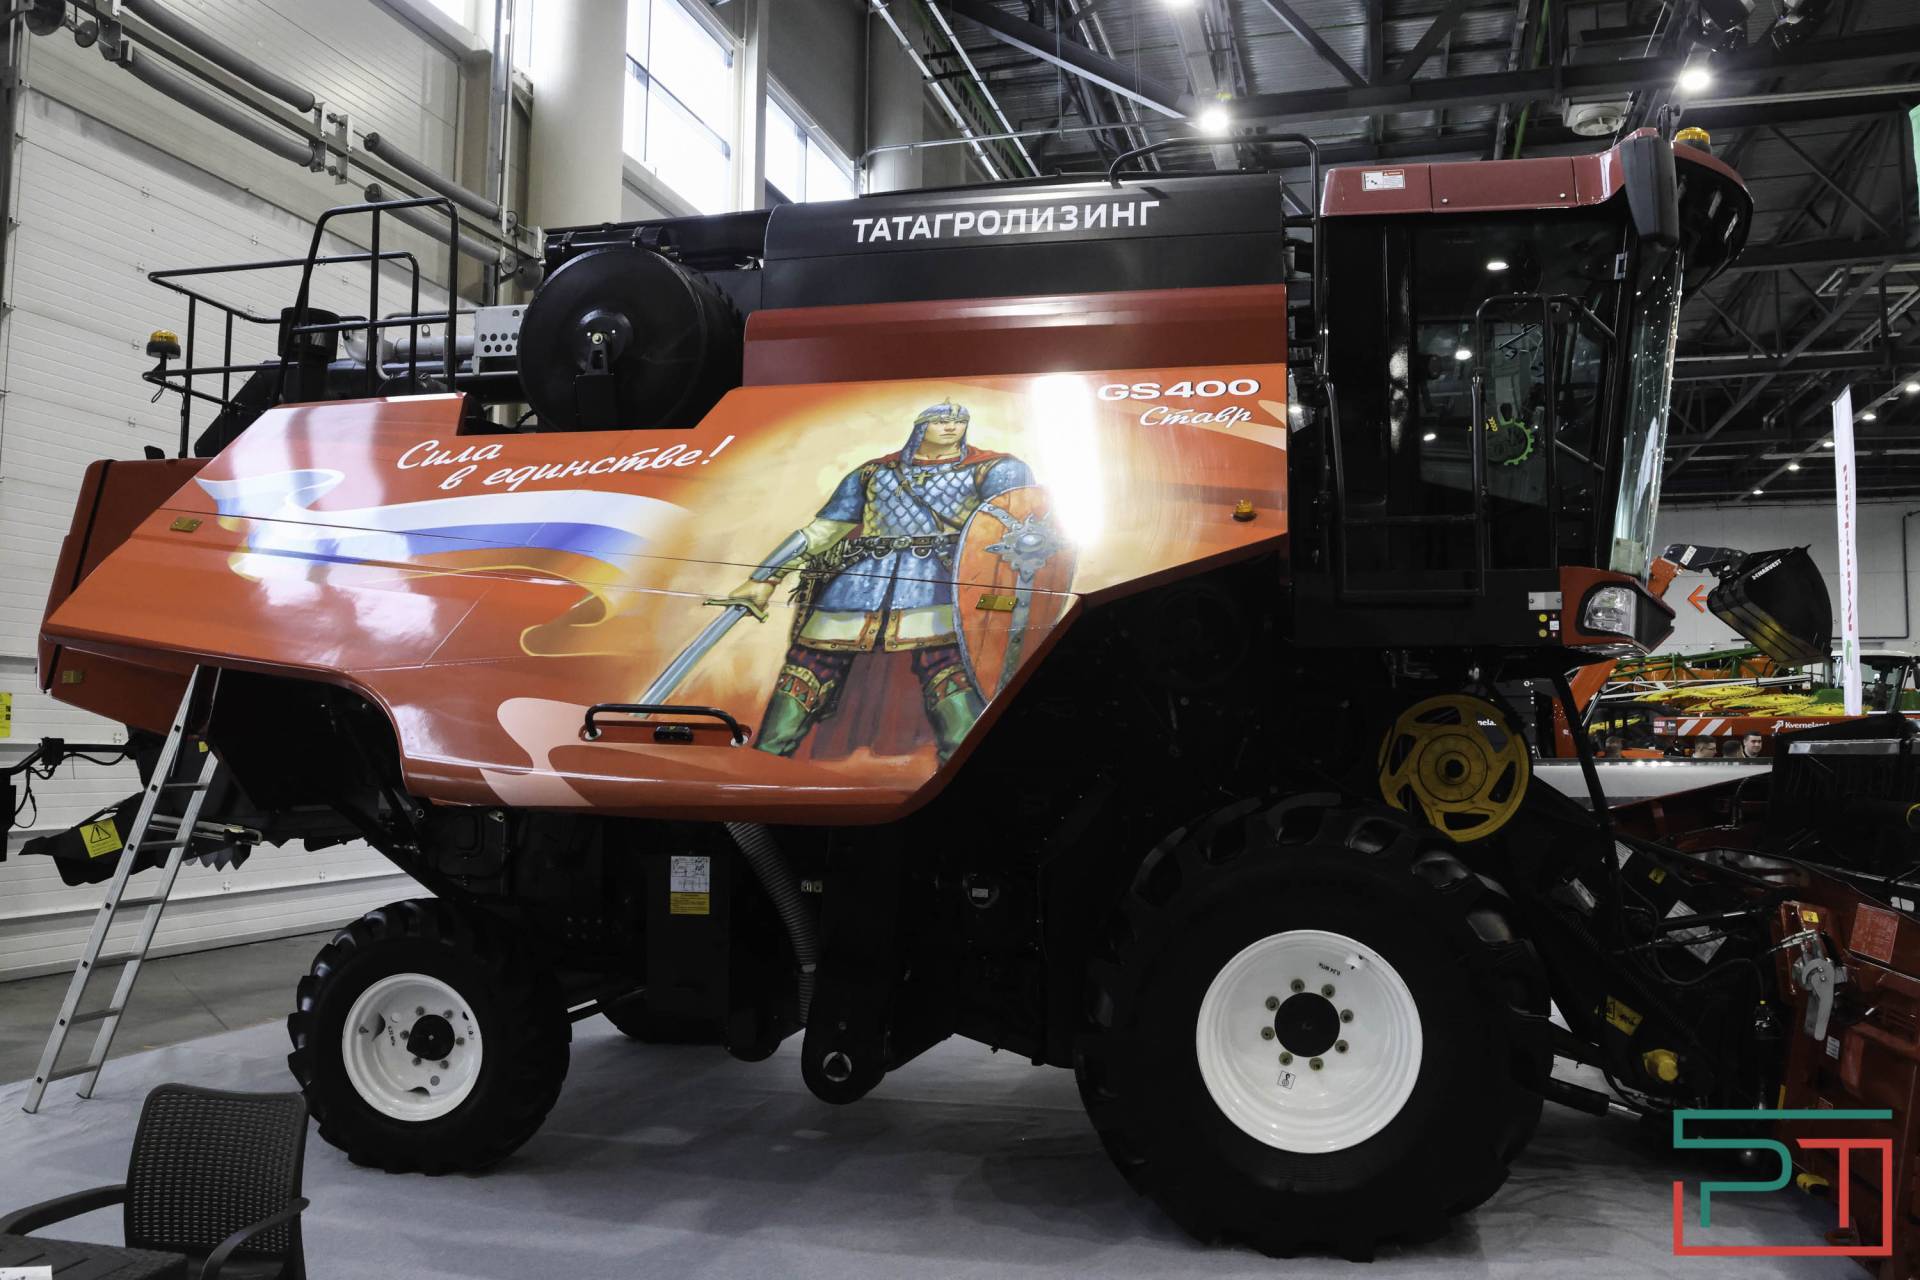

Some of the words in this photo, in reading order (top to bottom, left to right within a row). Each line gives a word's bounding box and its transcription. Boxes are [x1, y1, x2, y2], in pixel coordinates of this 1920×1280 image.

[852, 200, 1160, 243] ТАТАГРОЛИЗИНГ
[1140, 406, 1252, 428] Ставр
[397, 440, 504, 470] Сила
[437, 464, 478, 490] в
[483, 435, 736, 492] единстве!
